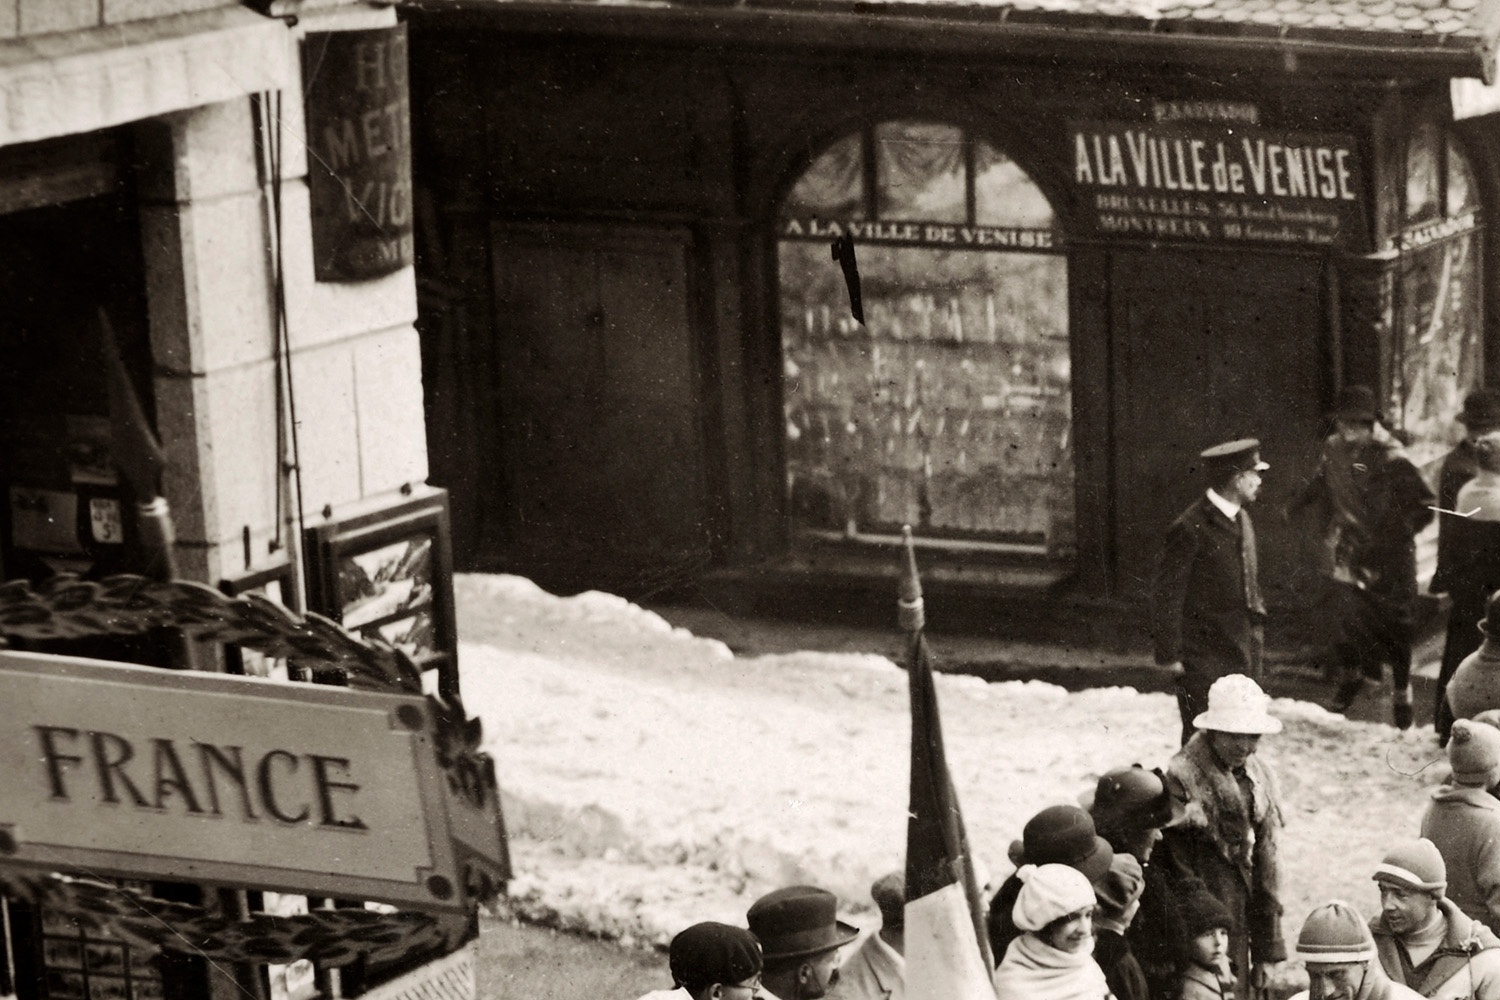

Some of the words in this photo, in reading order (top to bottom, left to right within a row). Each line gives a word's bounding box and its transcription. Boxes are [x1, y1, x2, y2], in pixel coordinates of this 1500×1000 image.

[1076, 132, 1094, 184] A
[1093, 134, 1128, 186] LA
[1125, 130, 1210, 191] VILLE
[1212, 142, 1246, 195] de
[1242, 138, 1357, 201] VENISE
[786, 218, 804, 236] A
[809, 218, 843, 237] LA
[848, 221, 920, 241] VILLE
[925, 226, 956, 243] DE
[961, 227, 1053, 248] VENISE
[32, 725, 369, 832] FRANCE
